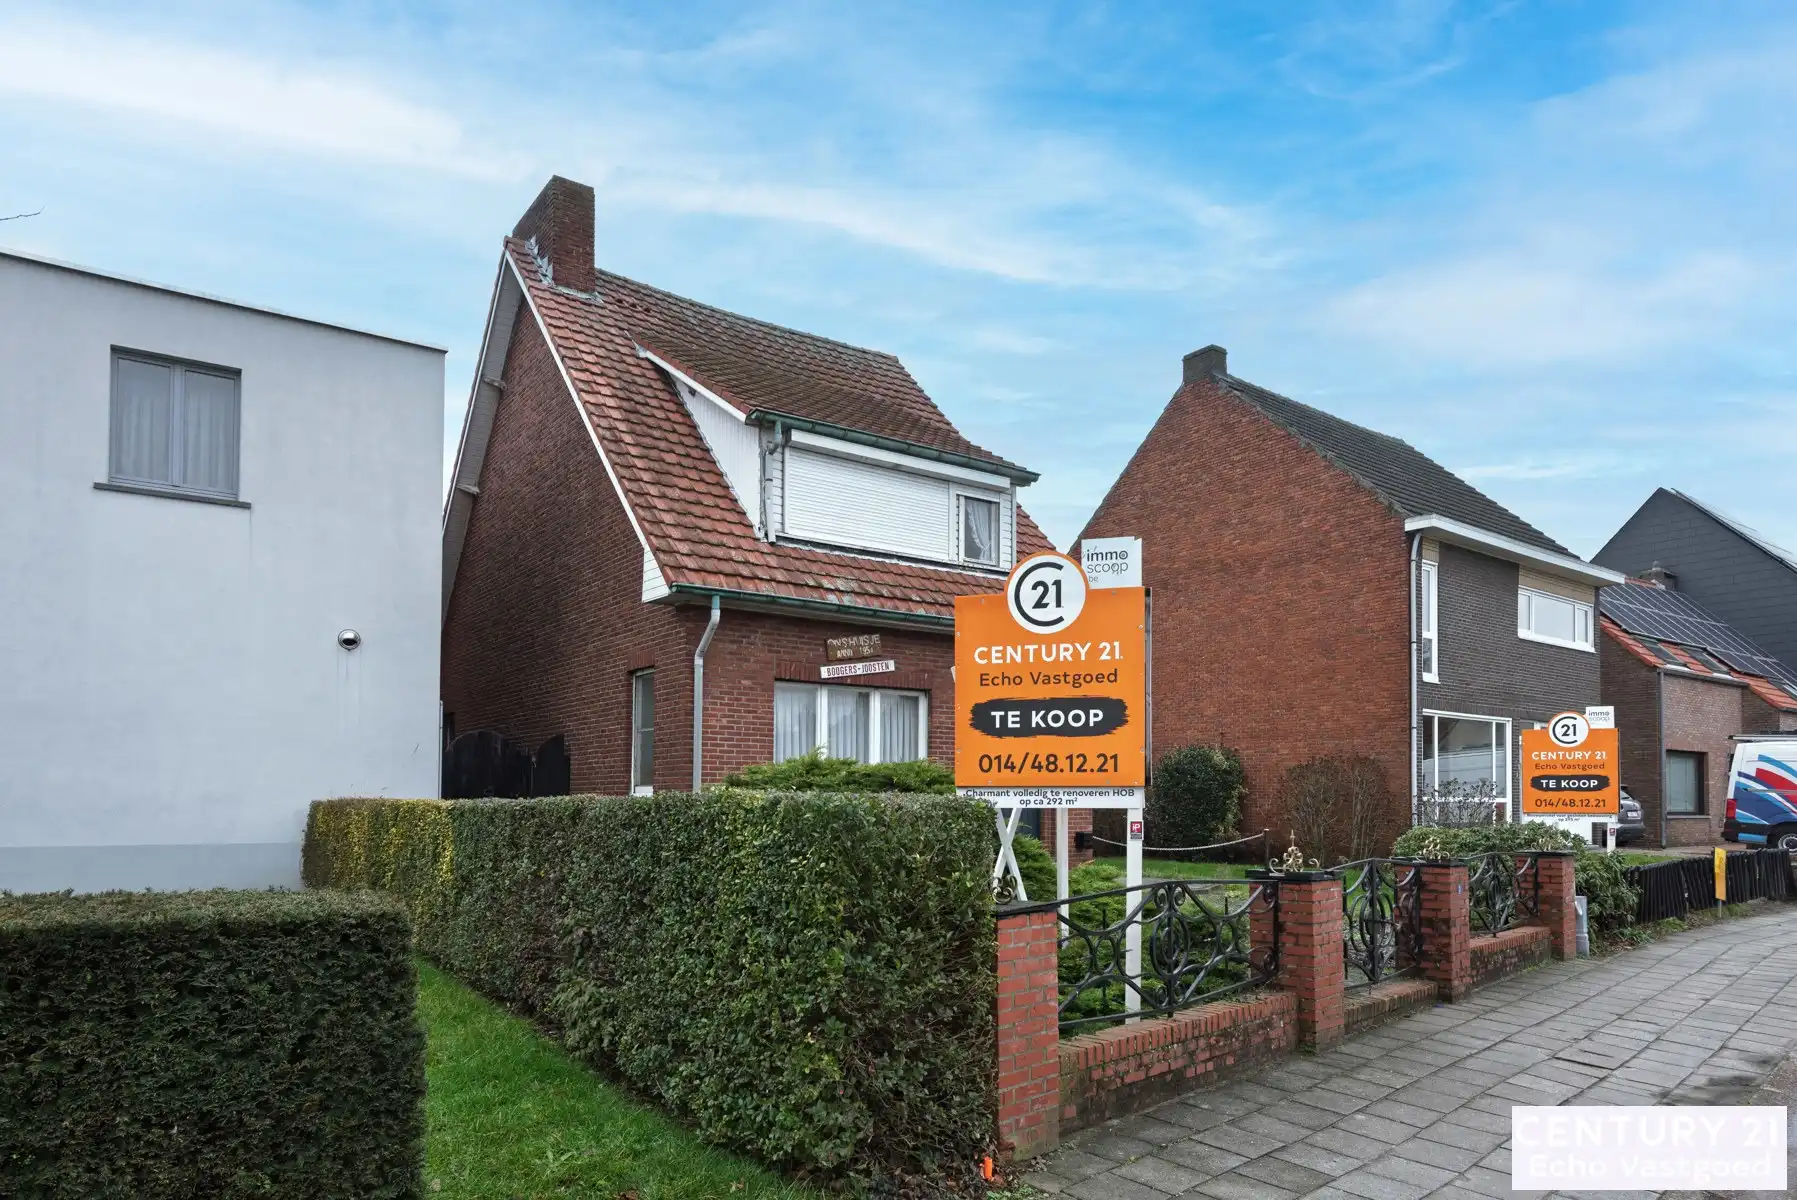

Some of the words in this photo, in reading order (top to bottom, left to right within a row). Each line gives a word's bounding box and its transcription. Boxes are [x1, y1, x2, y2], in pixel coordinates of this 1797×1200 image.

[1086, 547, 1128, 562] immo
[1087, 562, 1128, 575] scoop
[974, 642, 1092, 664] CENTURY
[1099, 641, 1122, 660] 21
[827, 661, 890, 677] BOOGERS-JOOSTEN
[979, 672, 1023, 687] Echo
[1030, 668, 1118, 688] Vastgoed
[991, 710, 1021, 729] TE
[1031, 709, 1104, 728] KOOP
[1531, 751, 1591, 760] CENTURY
[1595, 751, 1606, 760] 21
[978, 752, 1119, 774] 014/48.12.21
[1560, 763, 1605, 771] Vastgoed
[1540, 780, 1556, 788] TE
[1561, 780, 1598, 788] KOOP
[965, 789, 1010, 797] Charmant
[1013, 788, 1048, 799] volledig
[1050, 789, 1060, 797] te
[1062, 789, 1110, 797] renoveren
[1112, 788, 1135, 797] HOB
[1019, 798, 1031, 807] op
[1033, 798, 1044, 806] ca
[1046, 797, 1063, 805] 292
[1534, 797, 1606, 808] 014/48.12.21
